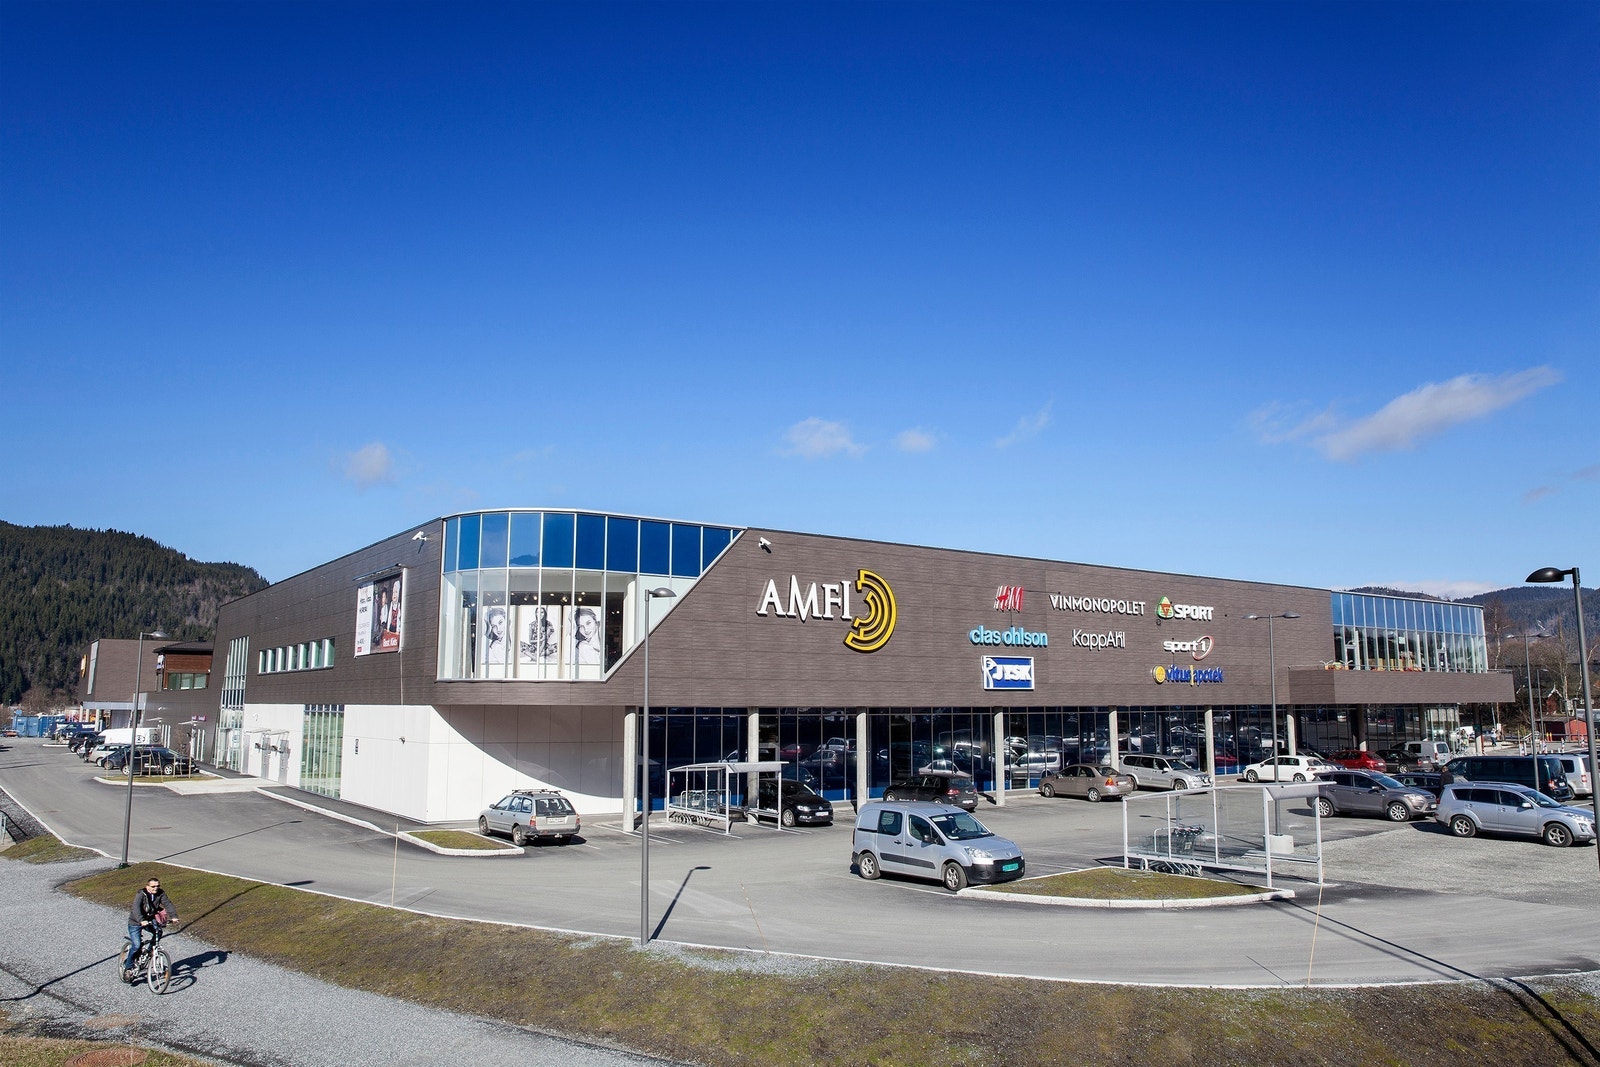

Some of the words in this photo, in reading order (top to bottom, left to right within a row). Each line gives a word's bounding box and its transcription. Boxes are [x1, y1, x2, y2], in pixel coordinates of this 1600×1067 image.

[756, 574, 853, 622] AMFI
[1049, 594, 1146, 615] VINMONOPOLET
[1173, 604, 1214, 620] SPORT
[969, 625, 1001, 644] clas
[1002, 626, 1048, 646] ohlson
[1072, 629, 1126, 651] KappAhl
[992, 664, 1032, 681] JYSK
